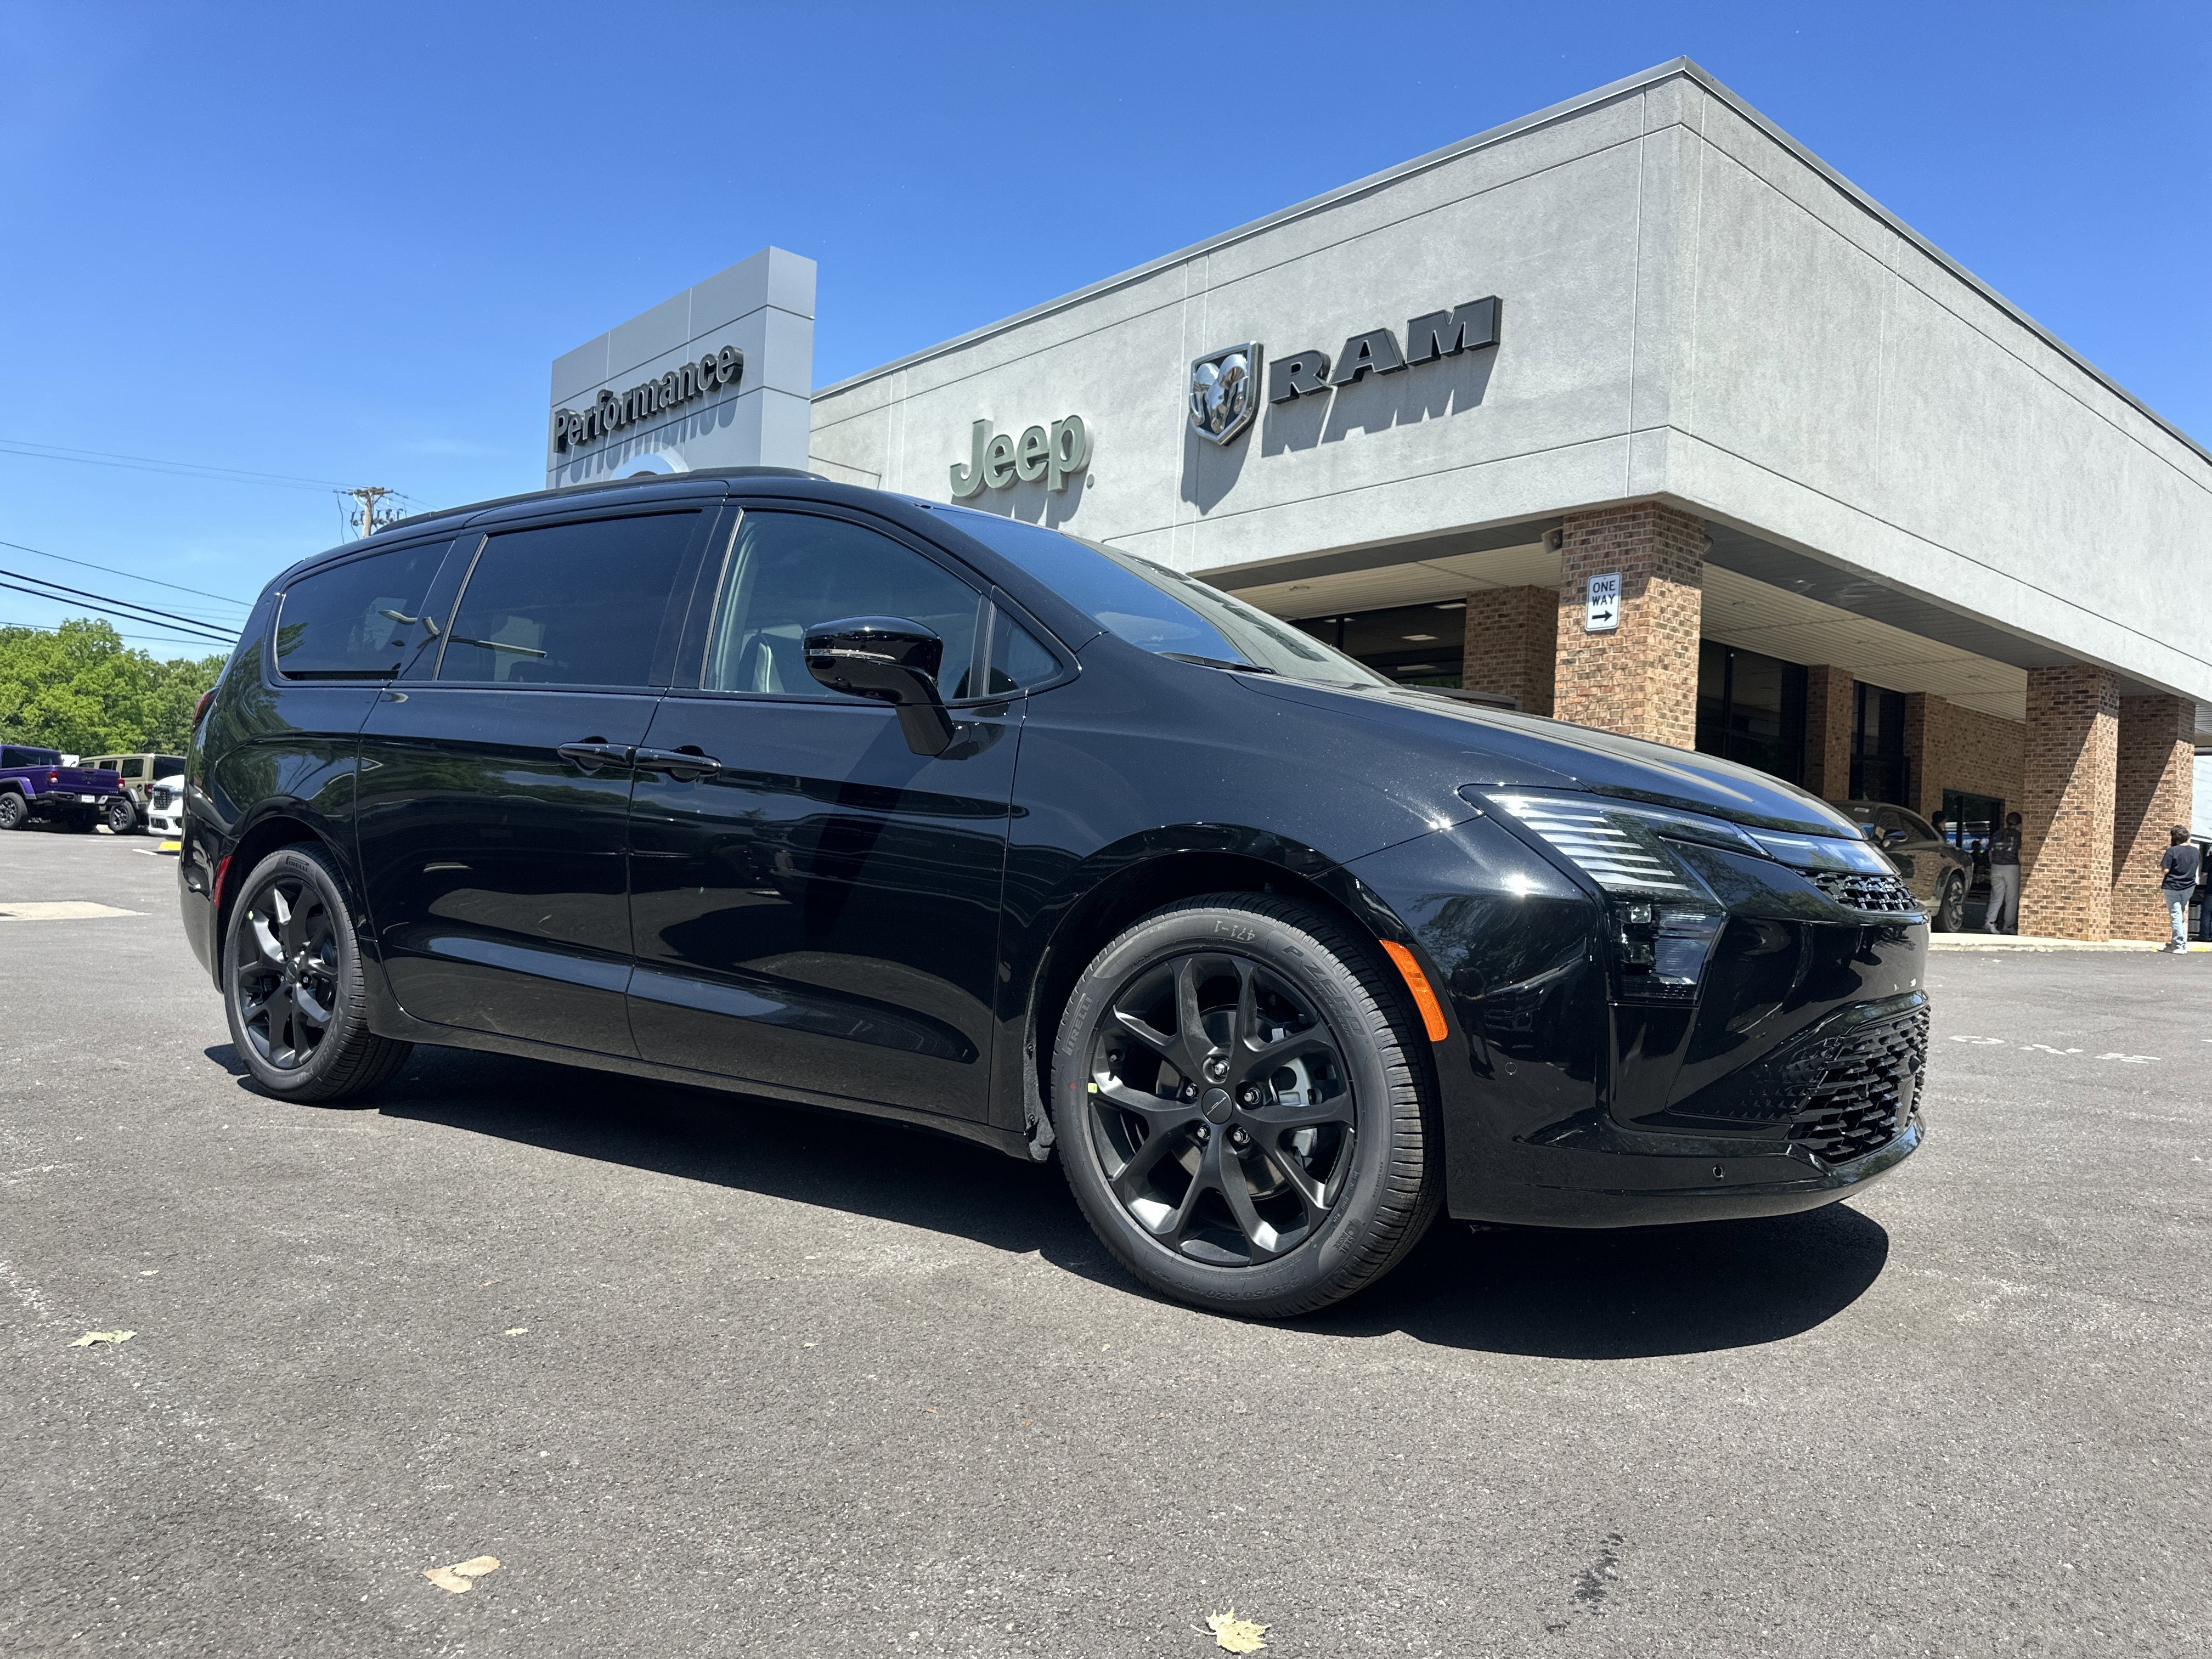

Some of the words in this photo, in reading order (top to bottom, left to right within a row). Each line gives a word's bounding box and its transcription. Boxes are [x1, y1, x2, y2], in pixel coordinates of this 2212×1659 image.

[1268, 295, 1503, 404] RAM
[554, 345, 744, 454] Performance
[950, 414, 1094, 497] Jeep
[1592, 594, 1616, 606] WAY
[1593, 580, 1616, 593] ONE
[286, 855, 309, 872] PIRELLI
[1282, 945, 1305, 957] P
[1304, 962, 1366, 1036] ZERO
[1062, 992, 1093, 1056] PIRELLI
[1339, 1237, 1355, 1254] SEAL
[1206, 1289, 1239, 1301] R20
